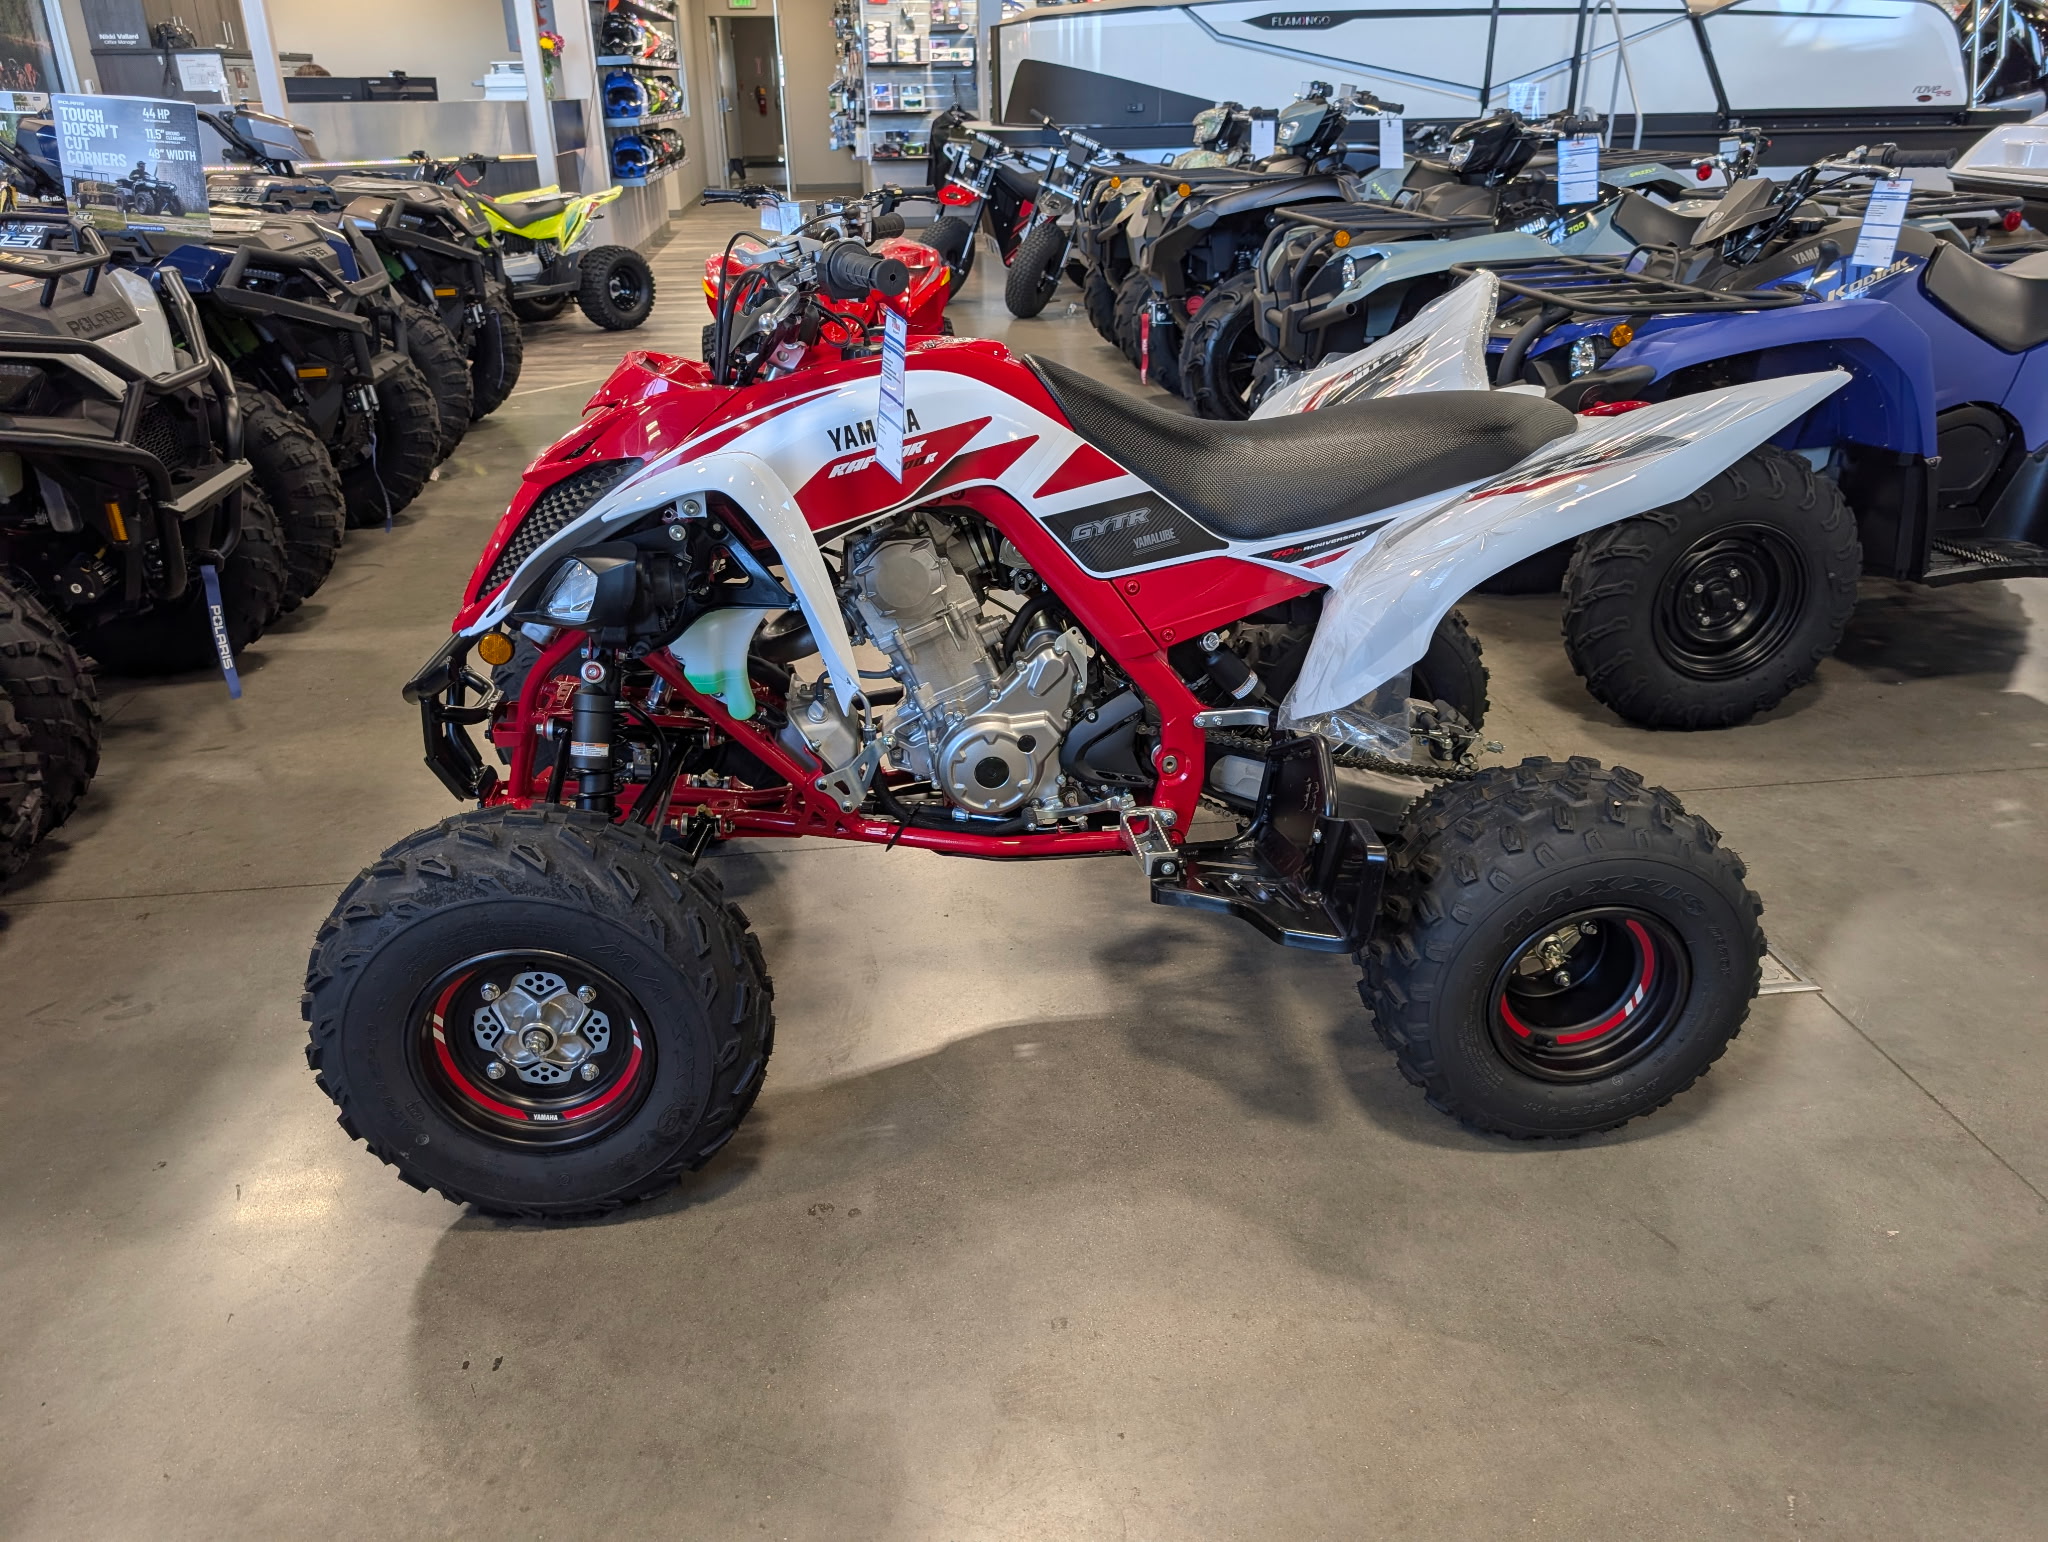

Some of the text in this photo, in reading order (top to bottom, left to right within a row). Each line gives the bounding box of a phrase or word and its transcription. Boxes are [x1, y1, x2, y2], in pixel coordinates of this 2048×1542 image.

[1271, 15, 1331, 27] FLAMINGO
[59, 106, 104, 123] TOUGH
[142, 107, 171, 120] 44 HP
[62, 121, 119, 139] DOESN'T
[64, 136, 90, 150] CUT
[66, 149, 127, 167] CORNERS
[165, 149, 197, 162] WIDTH
[1567, 221, 1586, 235] 700
[1791, 246, 1820, 265] YAMA
[66, 306, 127, 336] POLARIS
[826, 408, 922, 453] YAMA
[827, 439, 928, 480] RAPOR
[1070, 506, 1152, 542] GYTR
[1132, 527, 1177, 550] YAMALUBE
[1302, 529, 1368, 551] ANNIVERSARY
[210, 604, 234, 670] POLARIS
[1502, 873, 1708, 942] MAXXIS
[533, 1113, 559, 1121] YAMAHA
